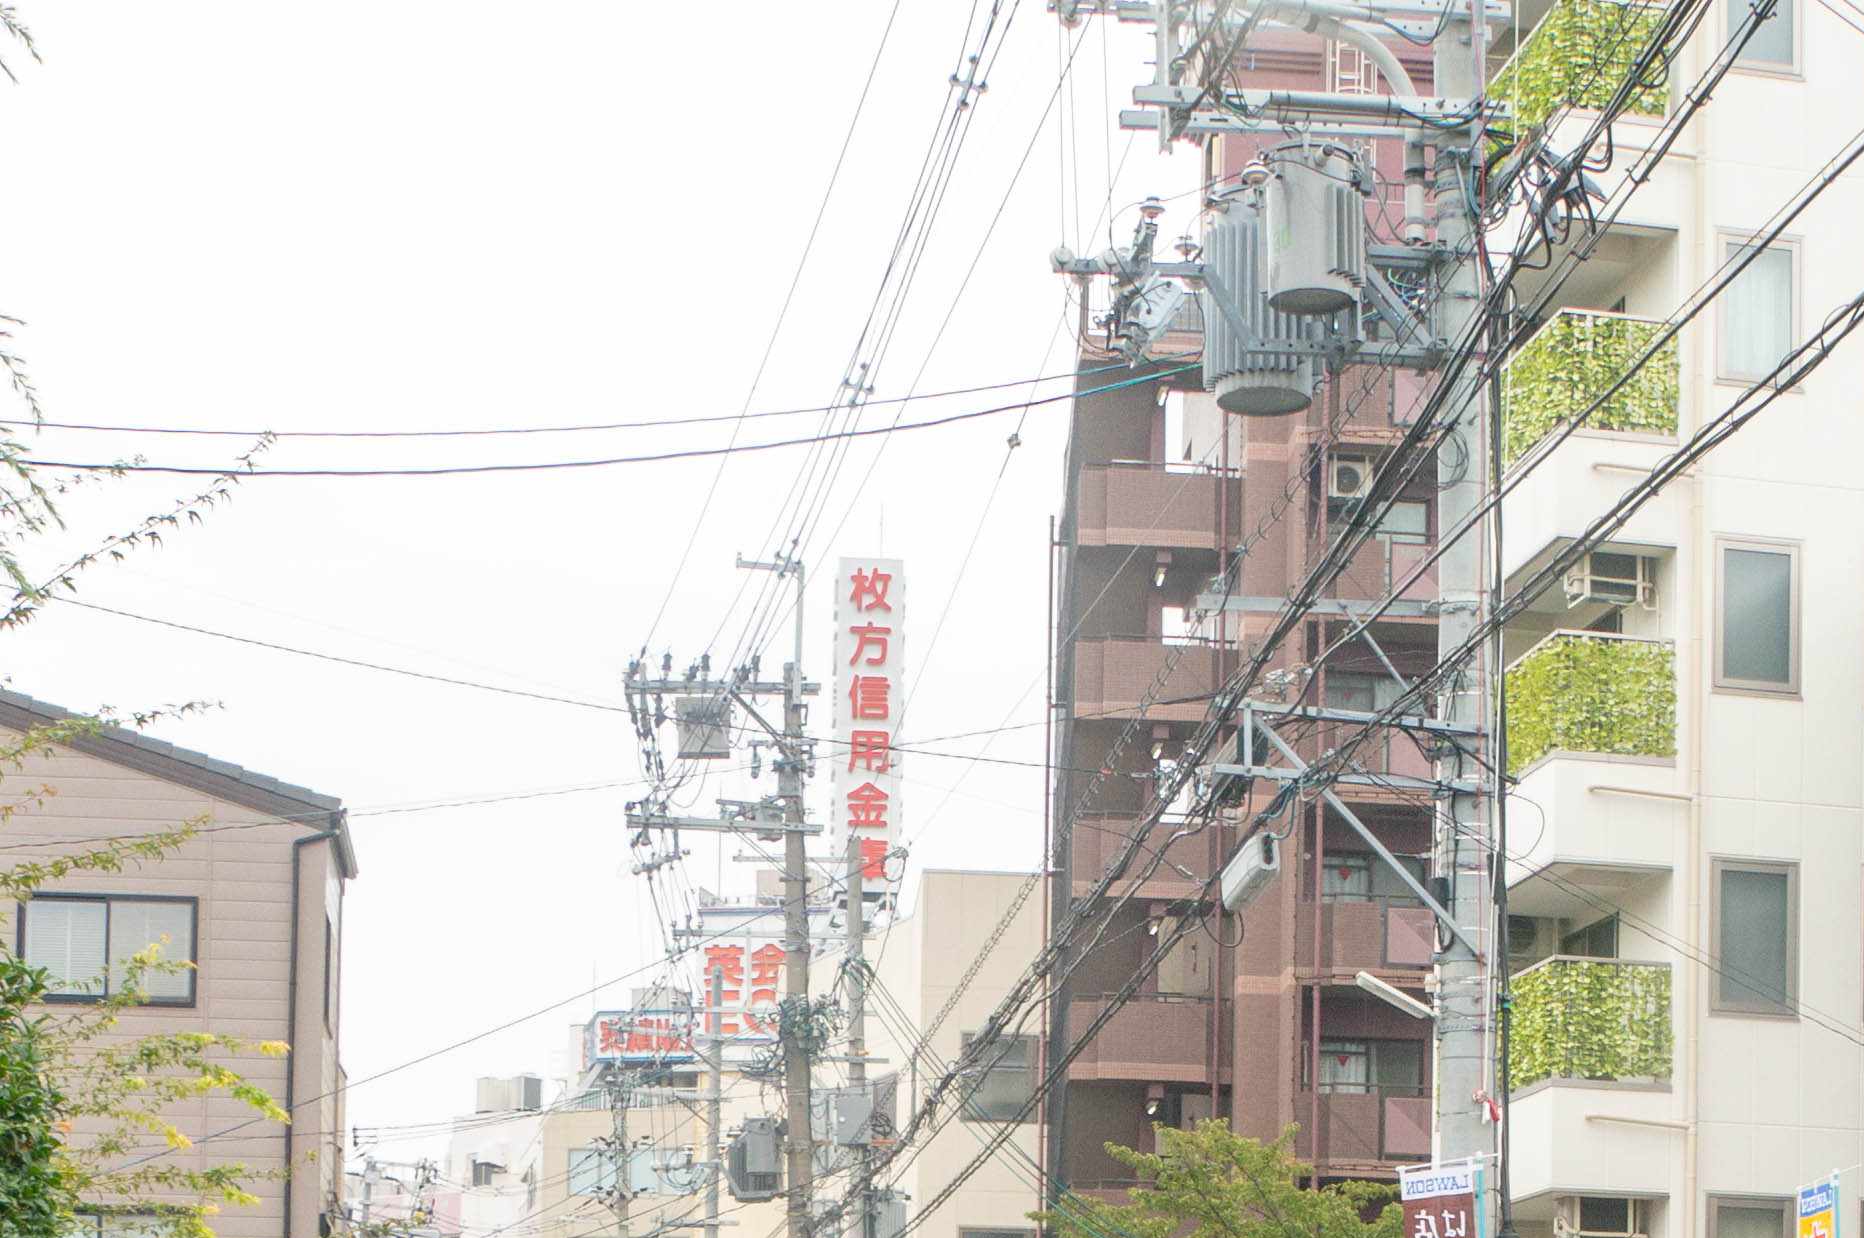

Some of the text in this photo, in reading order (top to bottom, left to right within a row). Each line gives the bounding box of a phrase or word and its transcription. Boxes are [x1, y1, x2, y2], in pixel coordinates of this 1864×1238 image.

[848, 567, 892, 880] 枚方信用金庫
